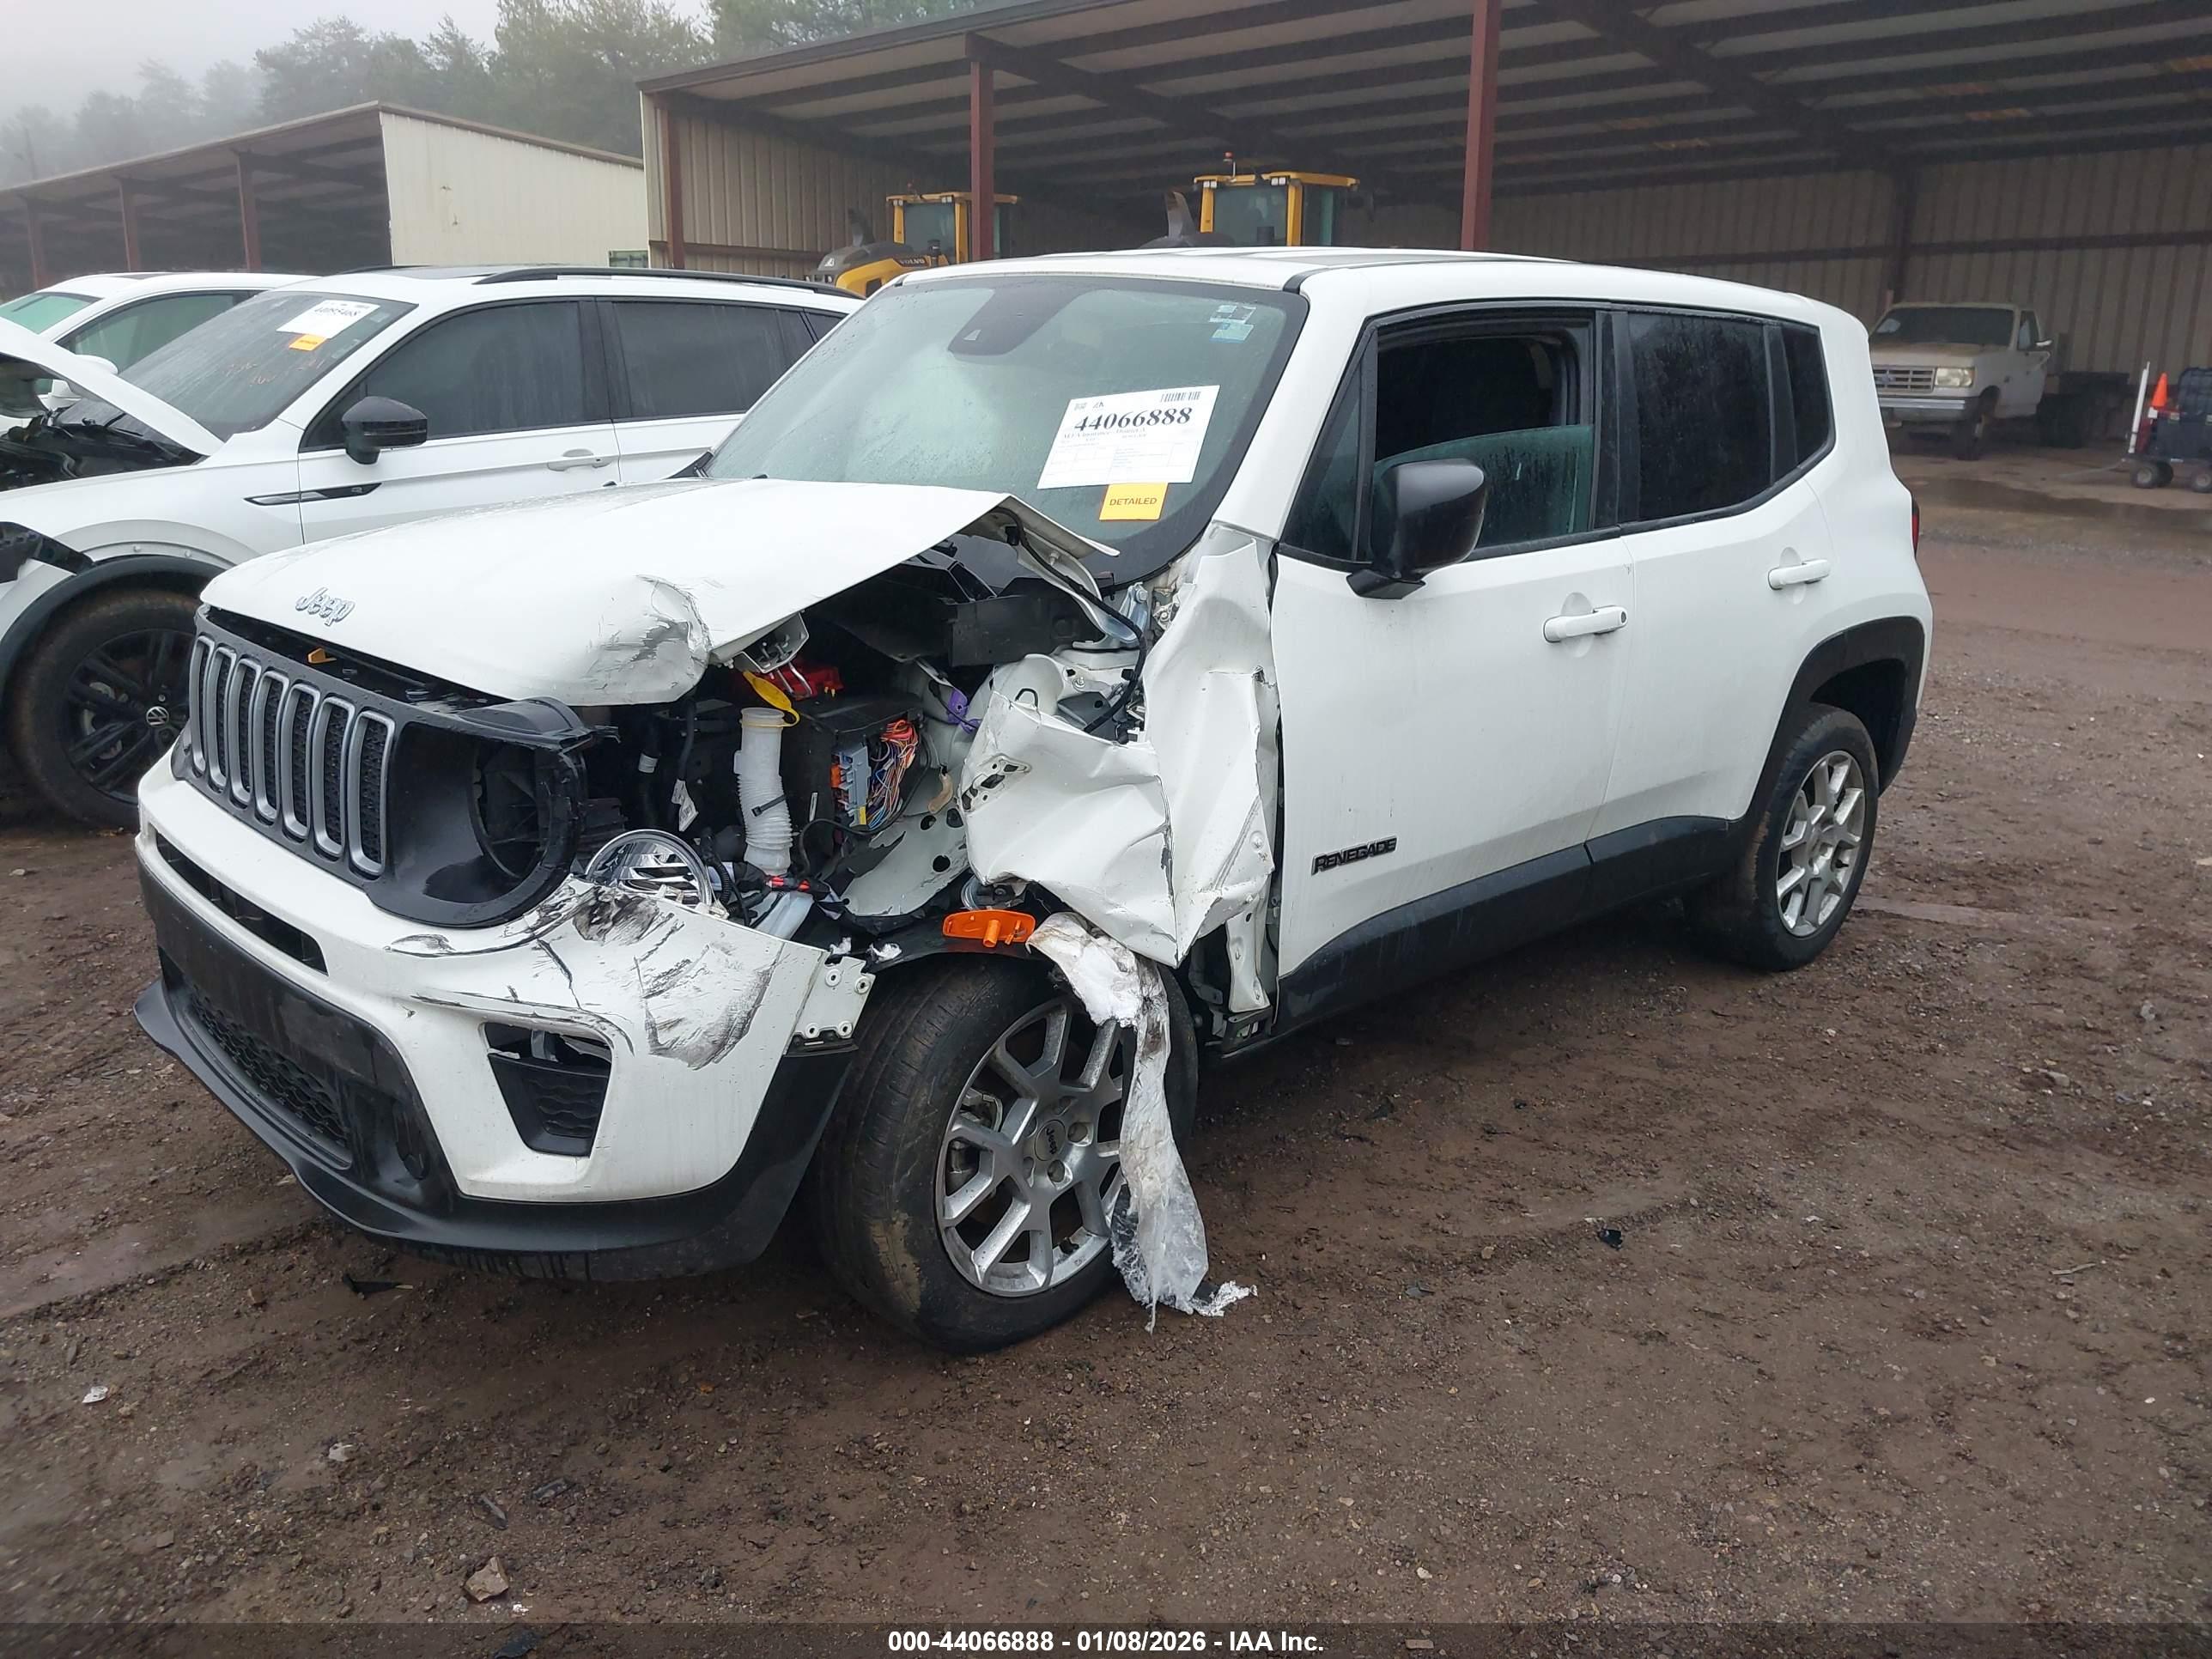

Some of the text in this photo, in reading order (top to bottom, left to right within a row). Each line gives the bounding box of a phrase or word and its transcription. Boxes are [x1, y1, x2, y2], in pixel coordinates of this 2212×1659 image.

[1074, 407, 1193, 431] 44066888
[295, 586, 356, 627] Jeep
[1311, 836, 1397, 876] RENEGADE
[1046, 1127, 1057, 1155] Jeep
